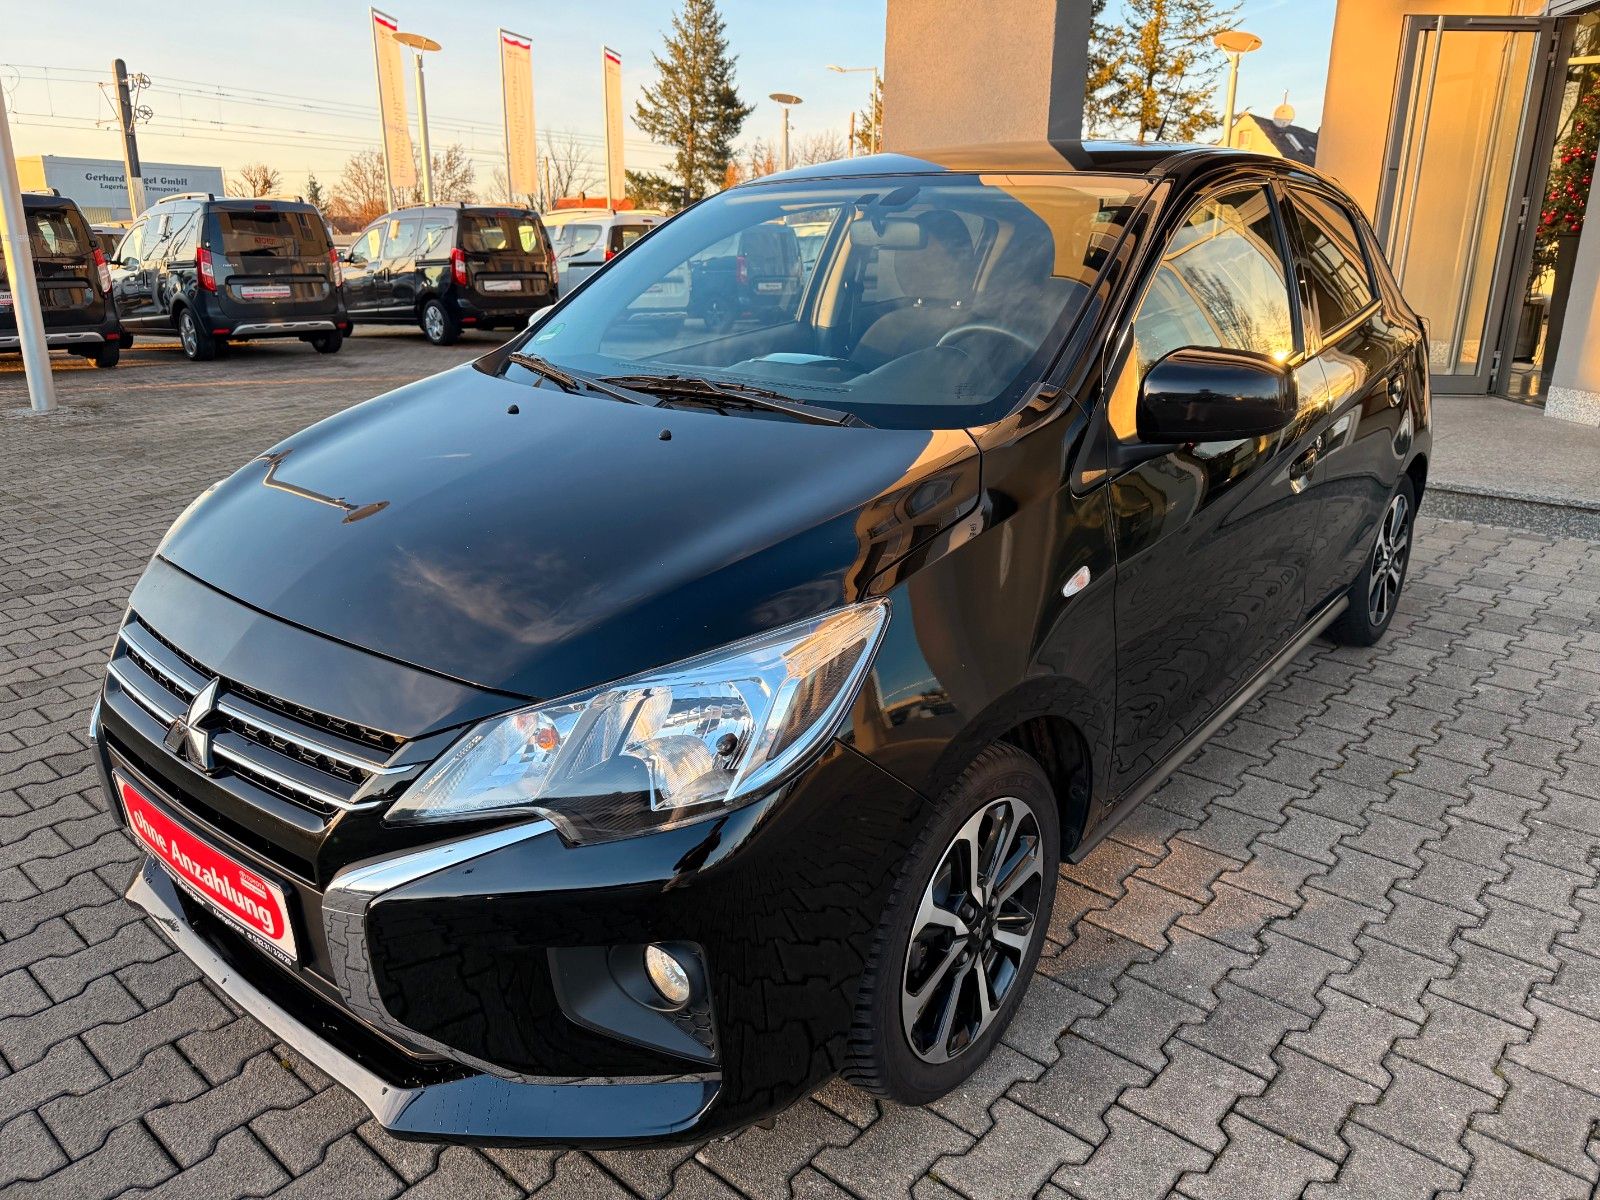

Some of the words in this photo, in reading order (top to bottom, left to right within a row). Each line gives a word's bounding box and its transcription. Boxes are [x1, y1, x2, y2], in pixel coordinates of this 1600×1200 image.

[85, 173, 125, 182] Gerhard
[160, 178, 188, 186] GmbH
[133, 809, 168, 854] ohne
[171, 839, 275, 935] Anzahlung
